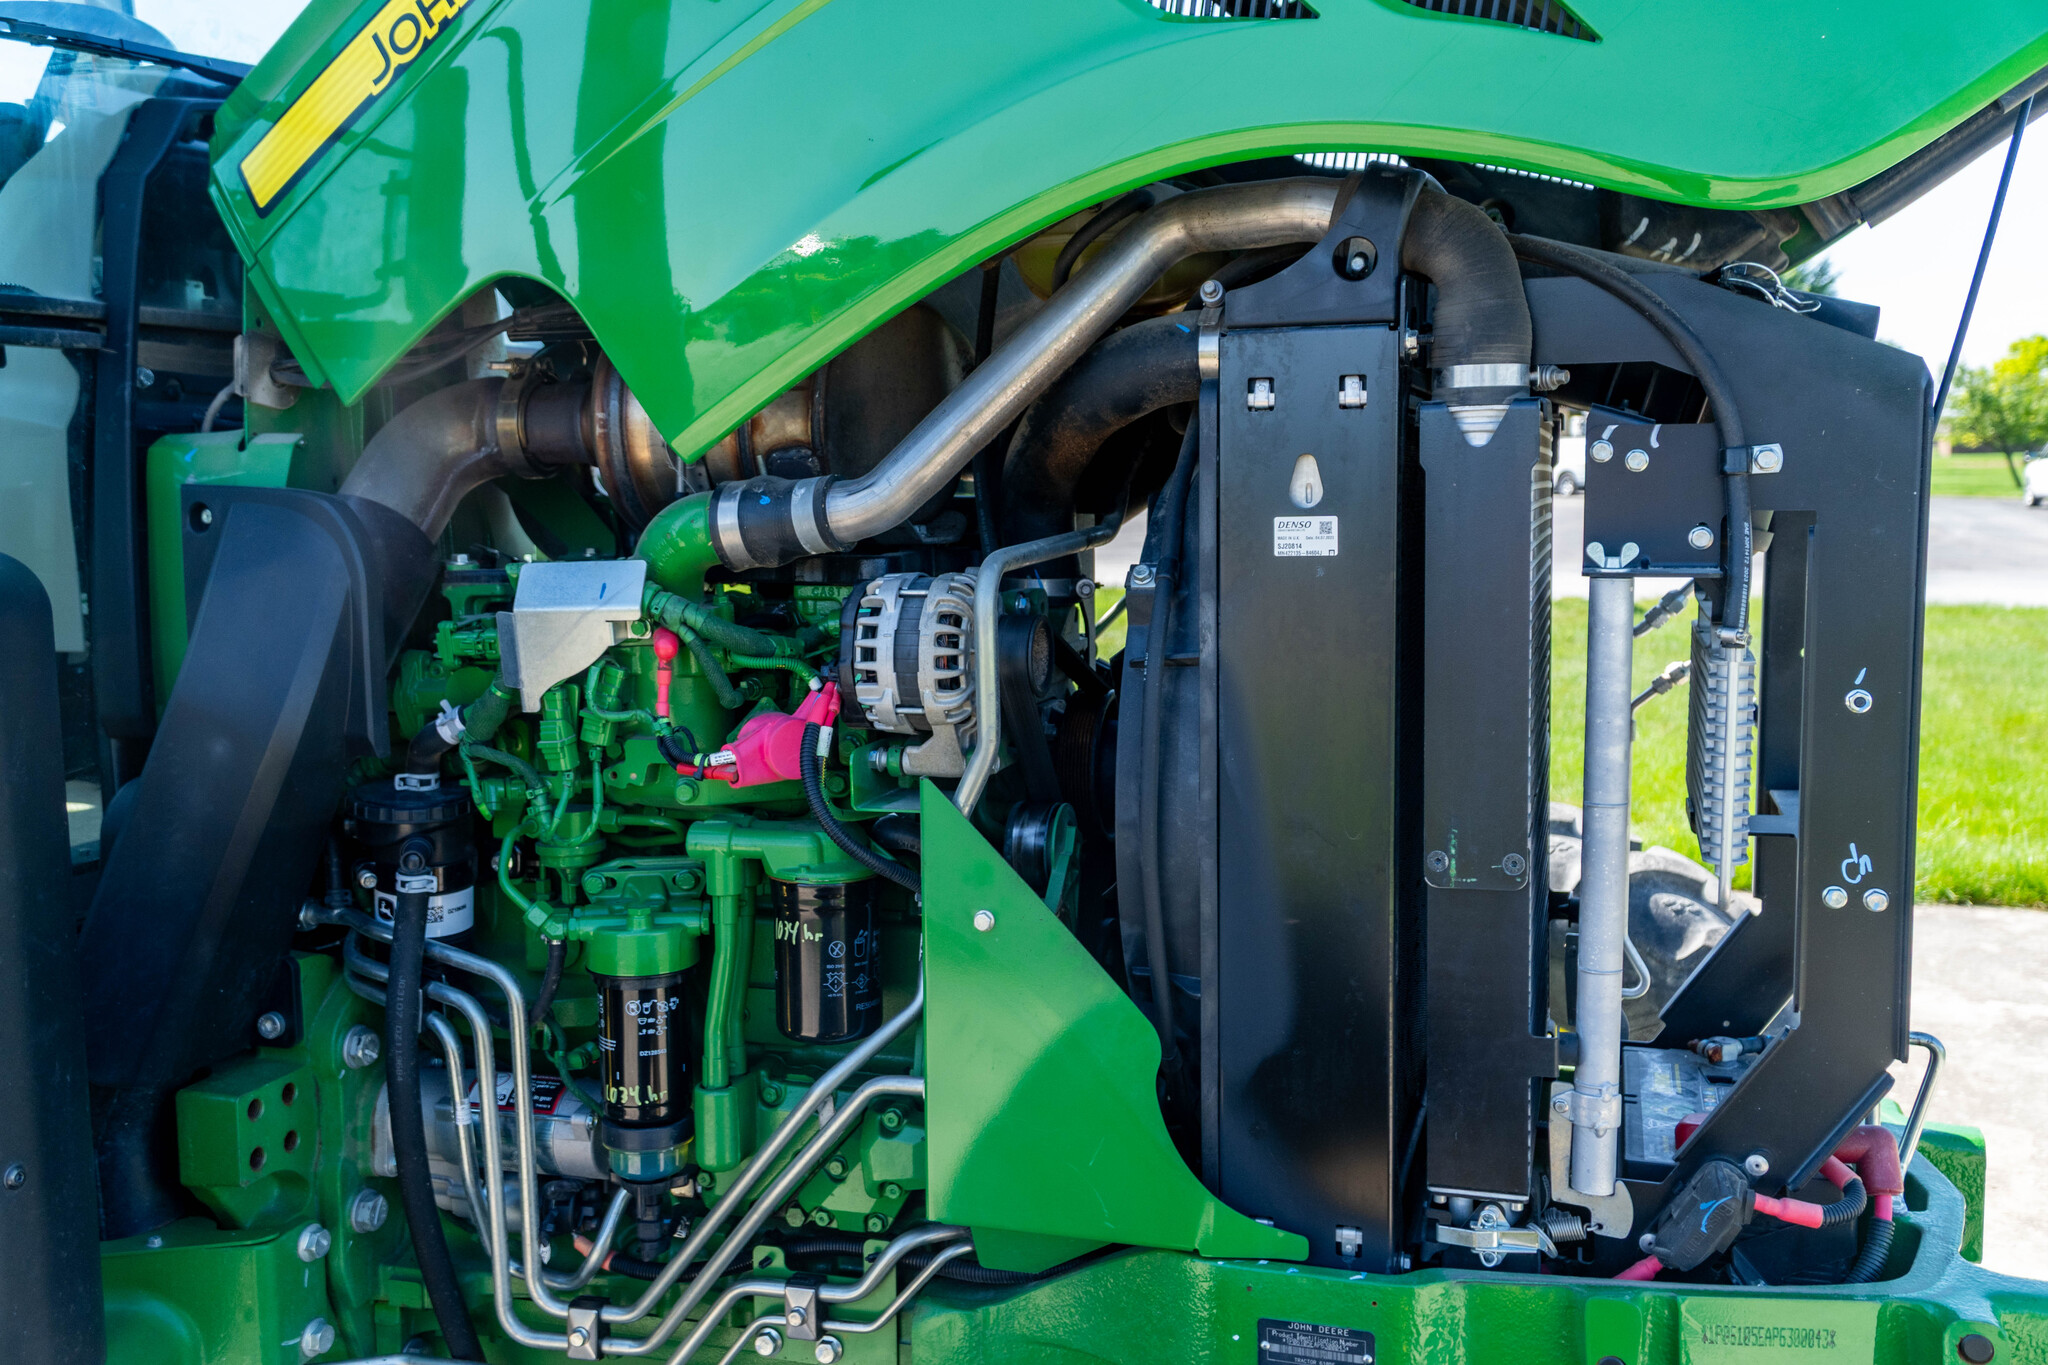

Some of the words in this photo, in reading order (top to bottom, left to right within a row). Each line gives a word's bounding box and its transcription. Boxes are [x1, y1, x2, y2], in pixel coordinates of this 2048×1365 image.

[1278, 521, 1312, 529] DENSO
[811, 586, 841, 597] CAST
[1287, 1322, 1313, 1332] JOHN
[1318, 1326, 1350, 1337] DEERE
[1271, 1329, 1294, 1339] Product
[1339, 1338, 1359, 1348] Number
